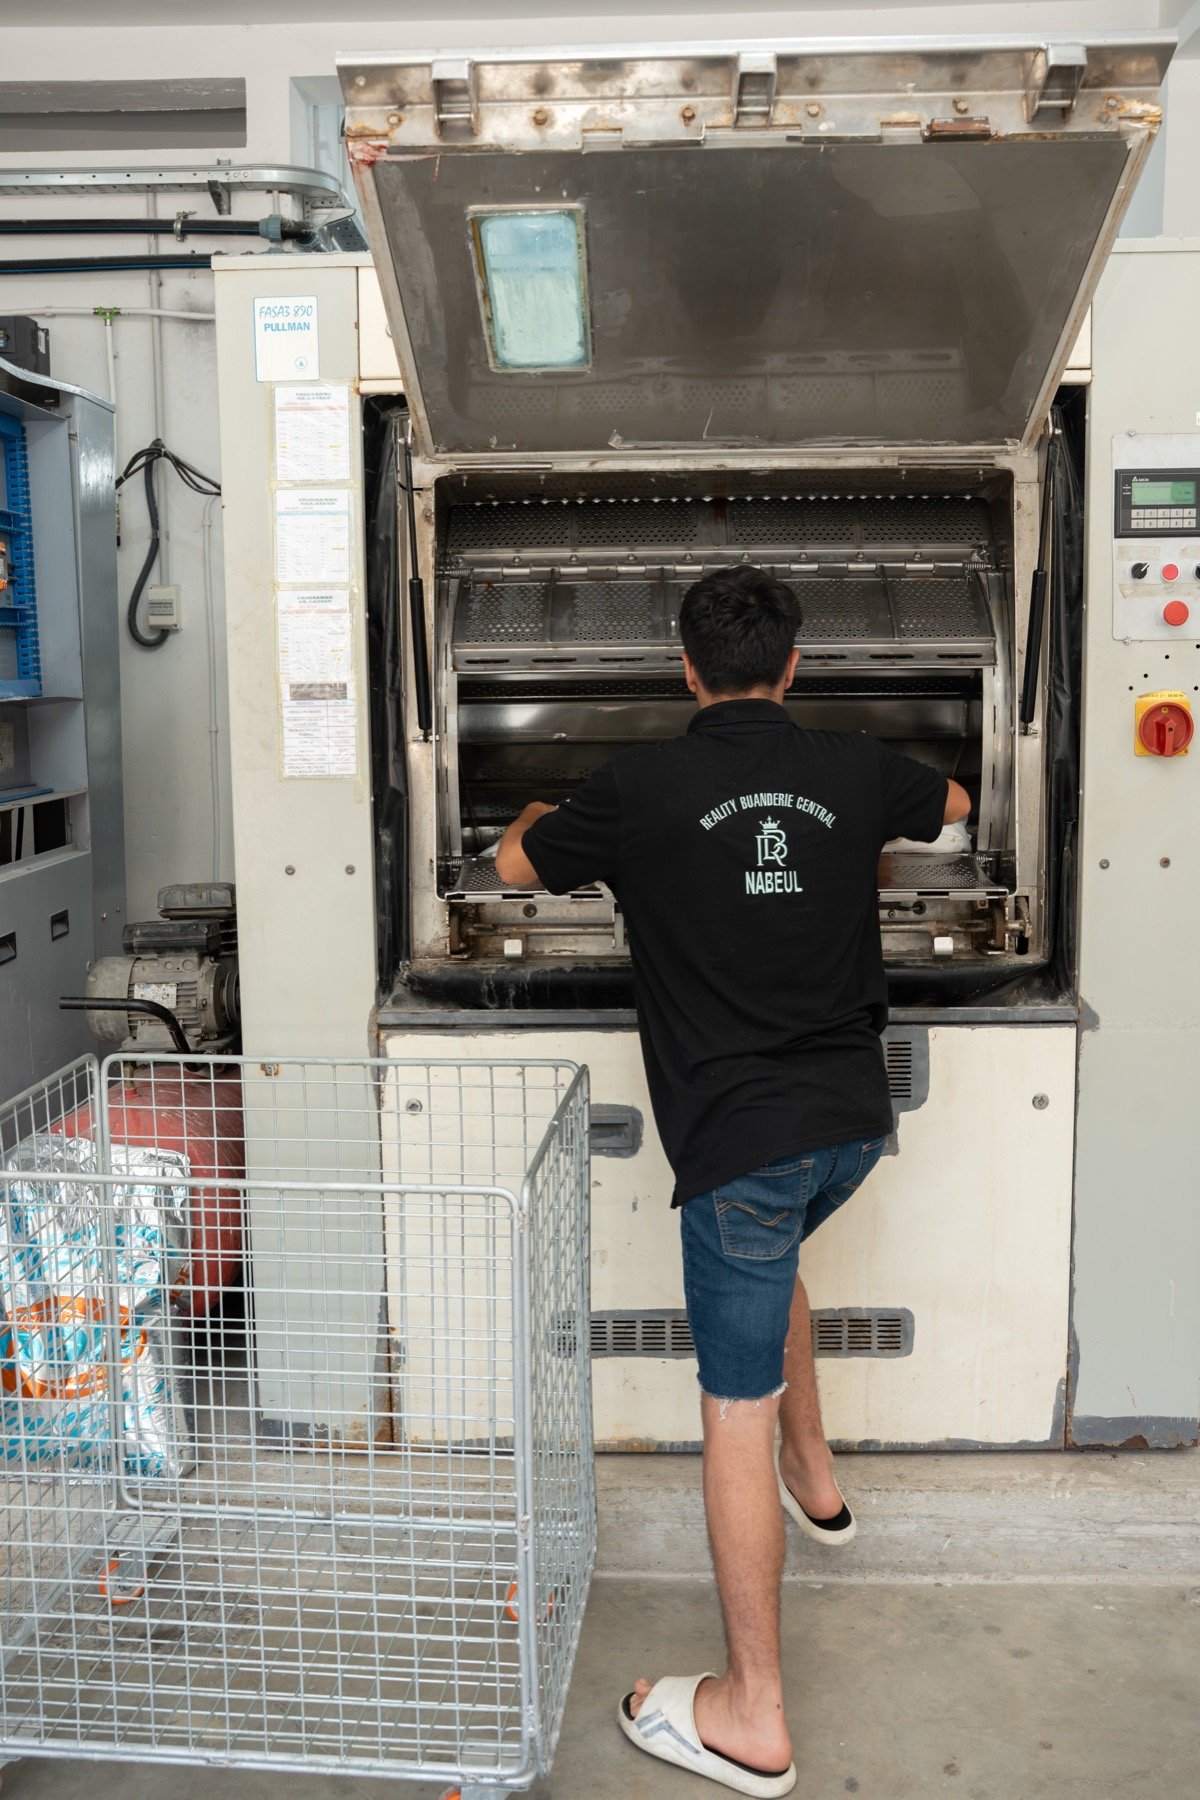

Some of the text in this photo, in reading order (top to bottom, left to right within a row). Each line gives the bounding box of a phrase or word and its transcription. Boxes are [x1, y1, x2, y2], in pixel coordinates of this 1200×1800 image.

[264, 322, 310, 332] PULLMAN
[699, 792, 837, 831] REALITY BUANDERIE CENTRAL
[745, 870, 803, 895] NABEUL
